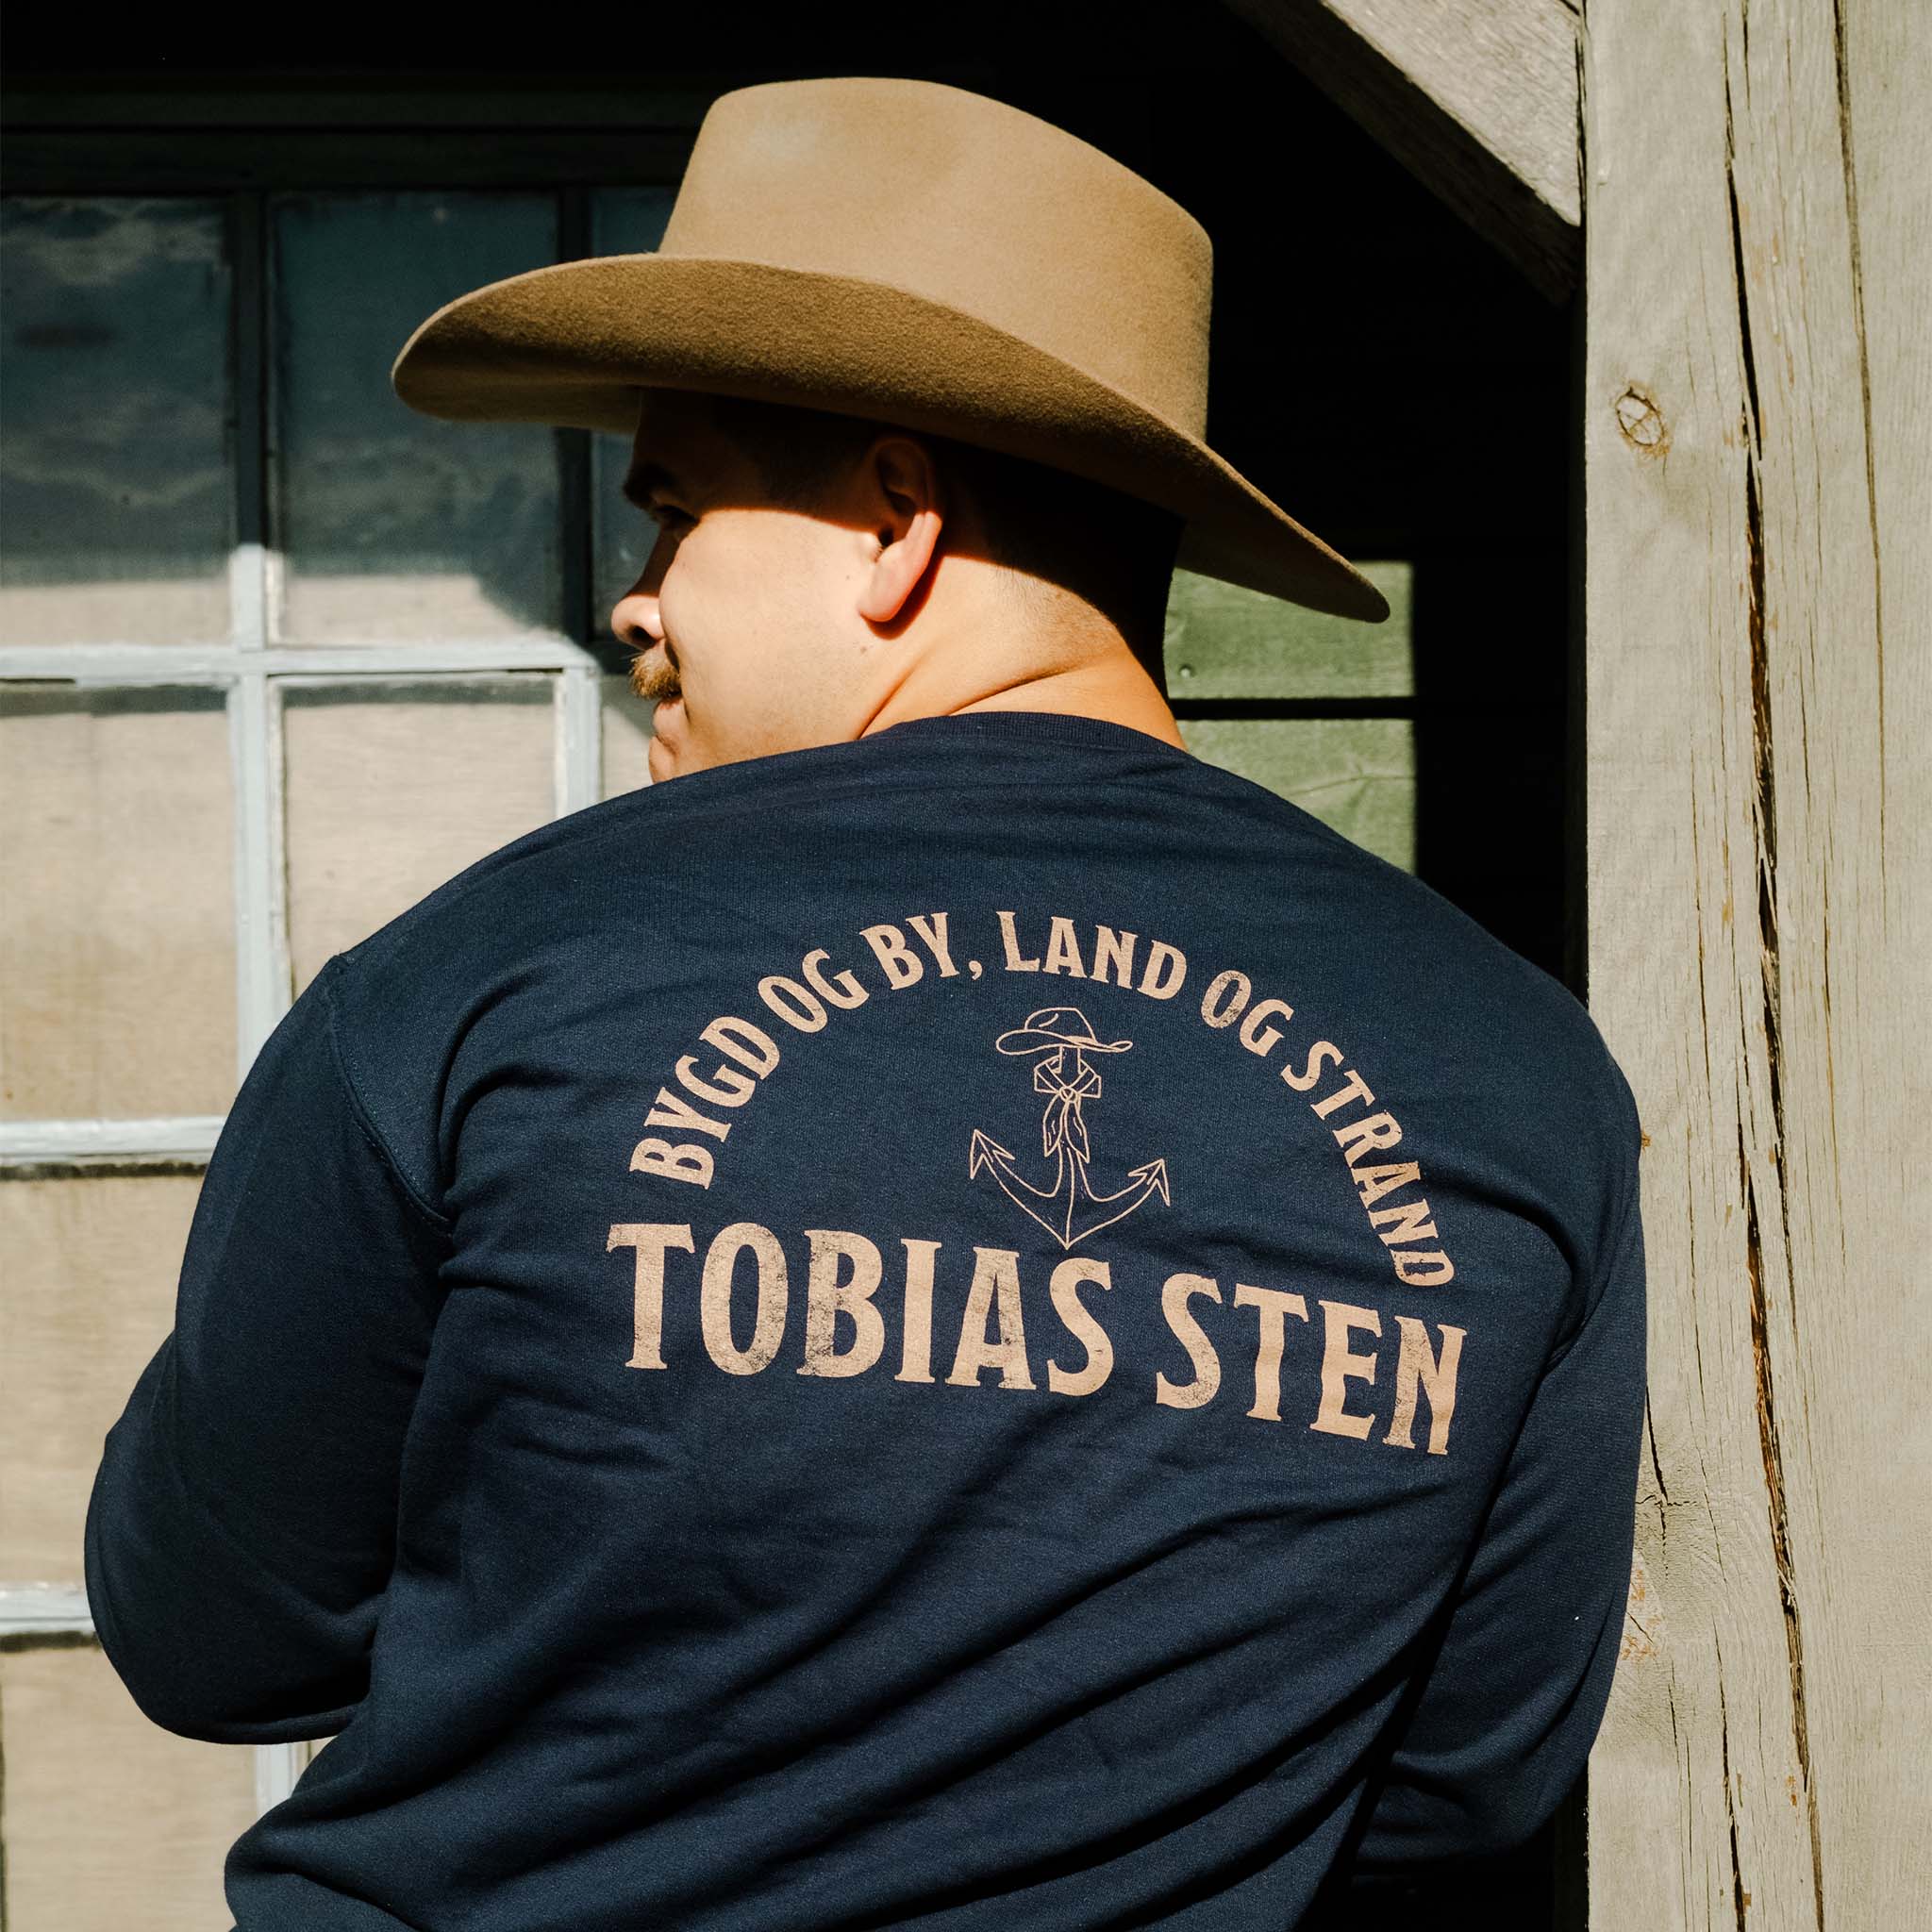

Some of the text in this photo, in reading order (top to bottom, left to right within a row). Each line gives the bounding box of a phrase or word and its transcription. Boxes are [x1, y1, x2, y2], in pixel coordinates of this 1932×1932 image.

[629, 910, 1456, 1288] BYGD OG BY, LAND OG STRAND
[607, 1222, 1467, 1456] TOBIAS STEN
